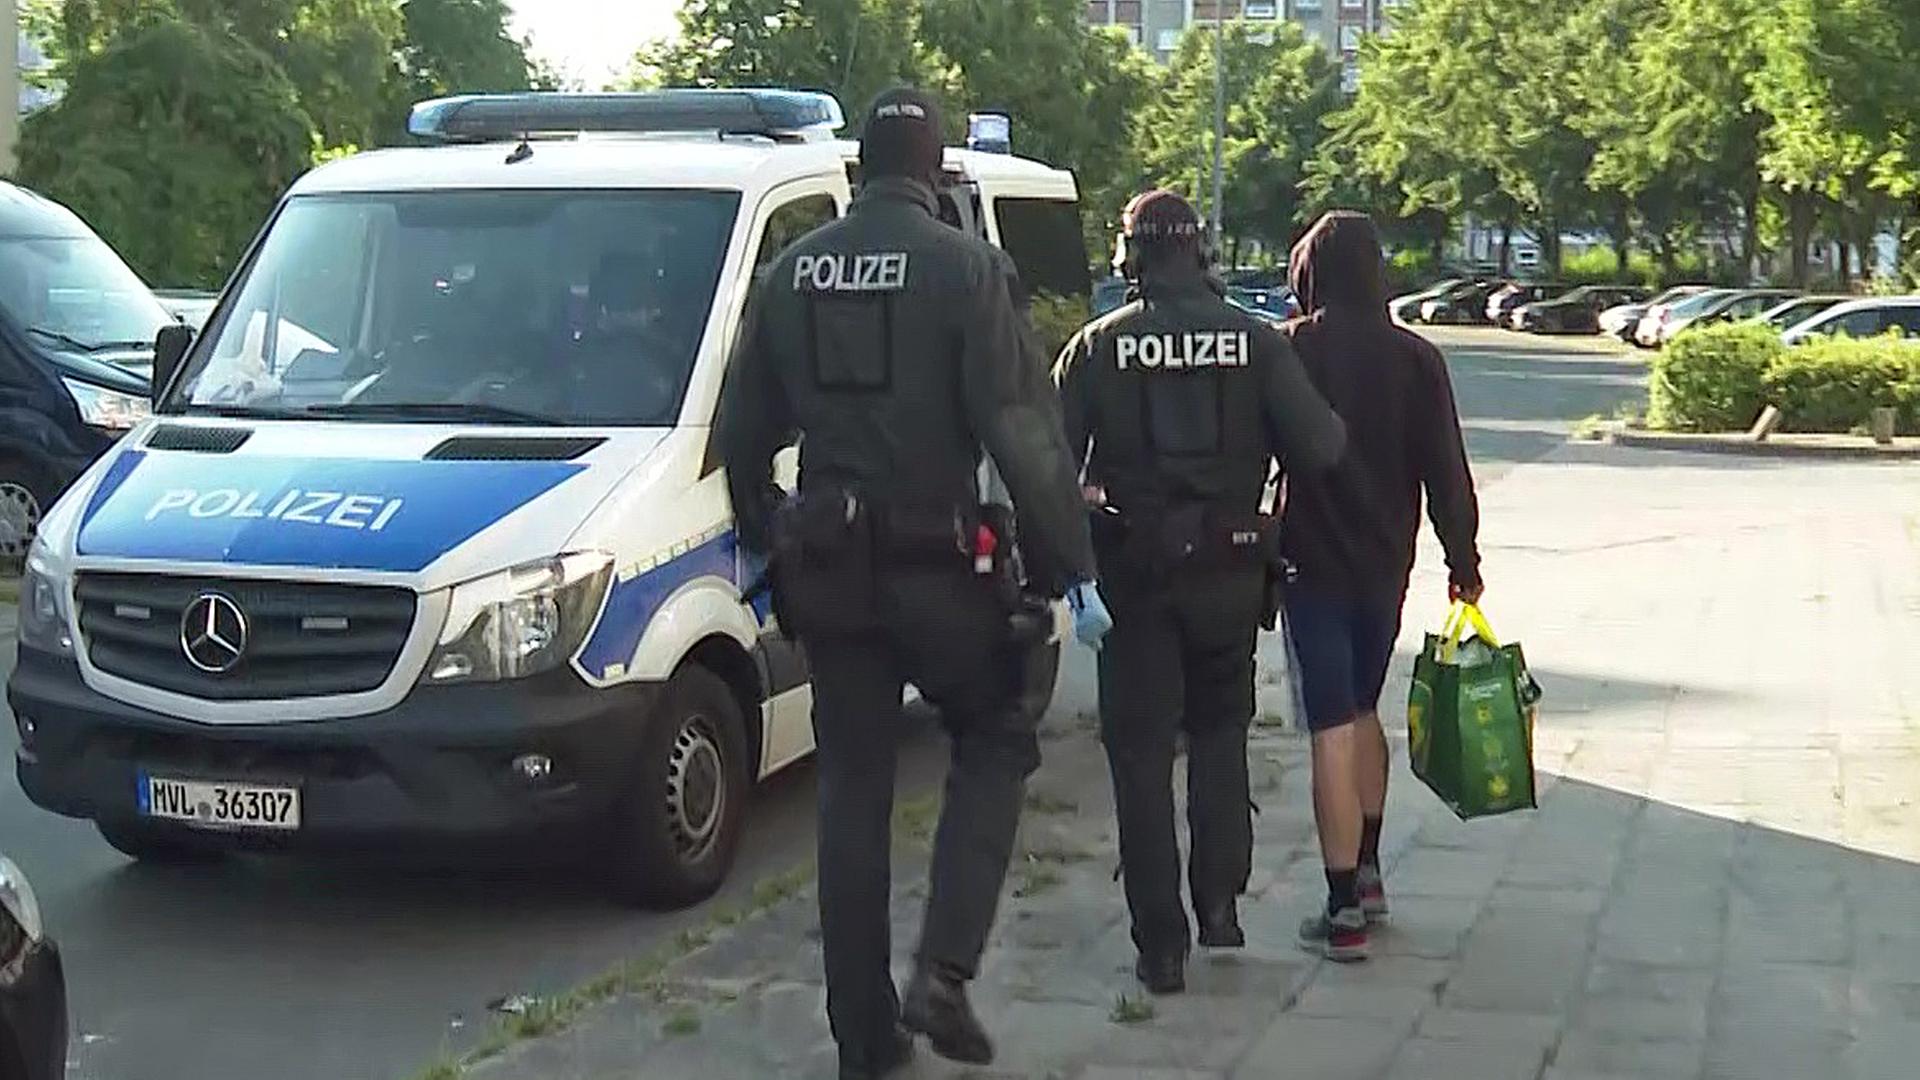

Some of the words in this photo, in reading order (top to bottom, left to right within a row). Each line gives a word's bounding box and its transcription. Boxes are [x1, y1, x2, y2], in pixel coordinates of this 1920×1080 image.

[793, 253, 907, 290] POLIZEI
[1116, 331, 1248, 369] POLIZEI
[145, 489, 403, 531] POLIZEI
[154, 782, 195, 815] MVL
[215, 788, 292, 822] 36307
